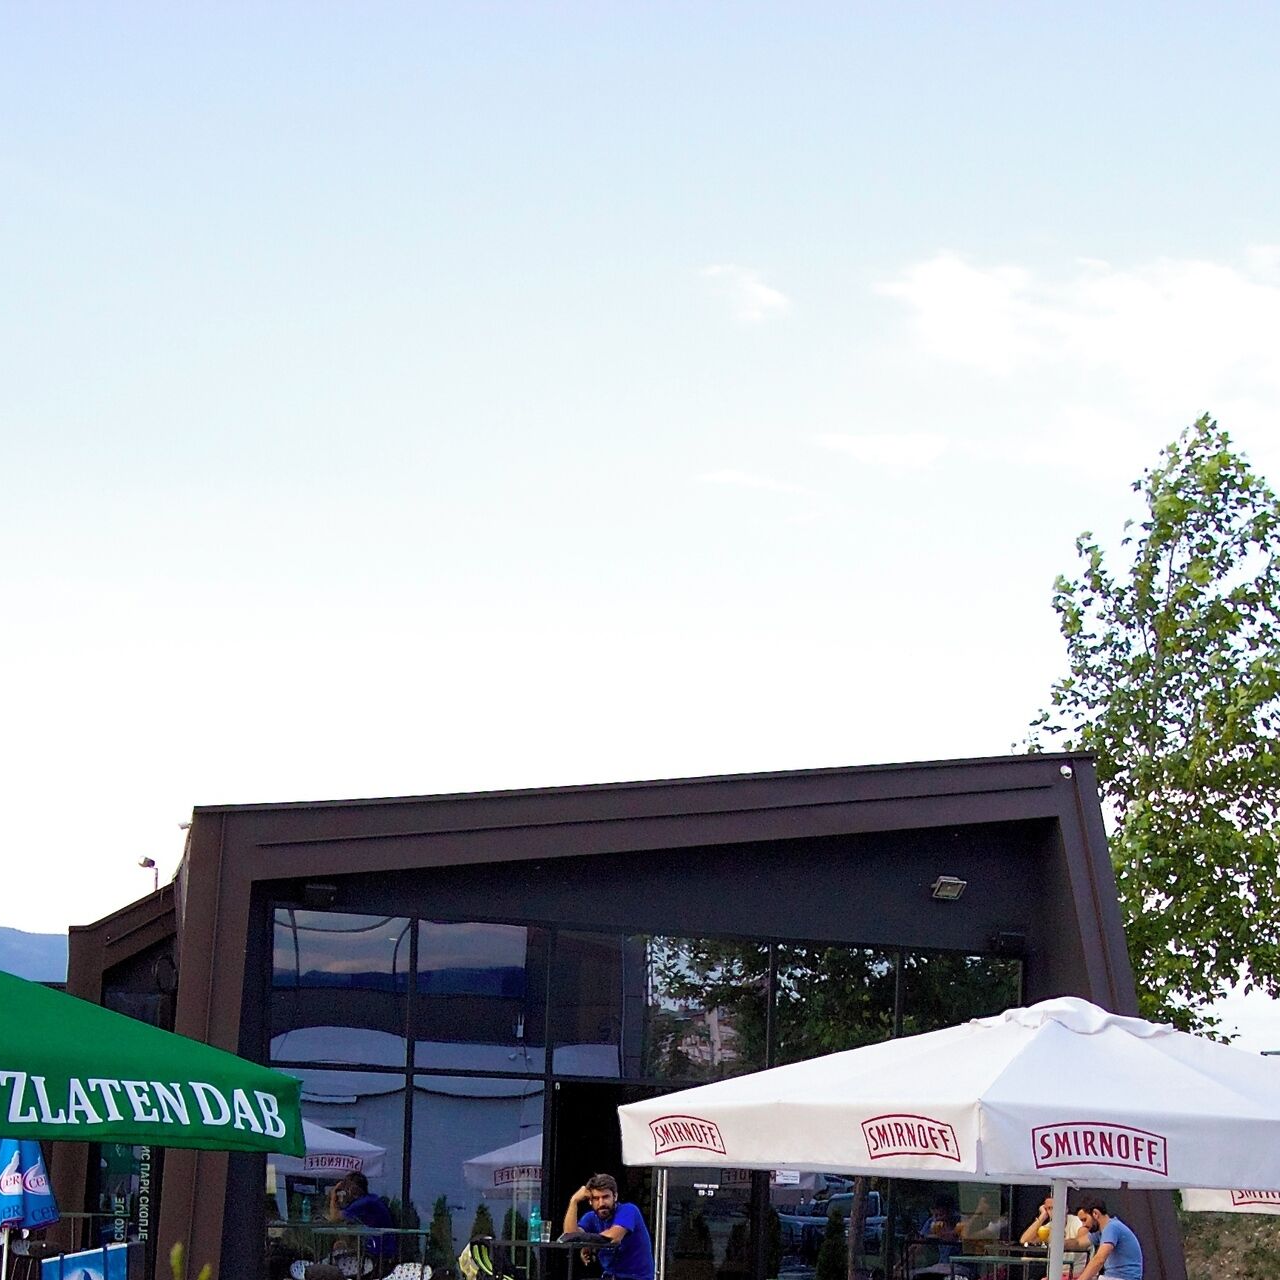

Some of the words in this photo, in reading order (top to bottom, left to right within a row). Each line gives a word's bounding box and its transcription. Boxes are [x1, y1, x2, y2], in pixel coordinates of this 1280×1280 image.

[188, 1080, 287, 1139] DAB
[654, 1121, 718, 1148] SMIRNOFF
[868, 1121, 952, 1153] SMIRNOFF
[1039, 1130, 1158, 1165] SMIRNOFF
